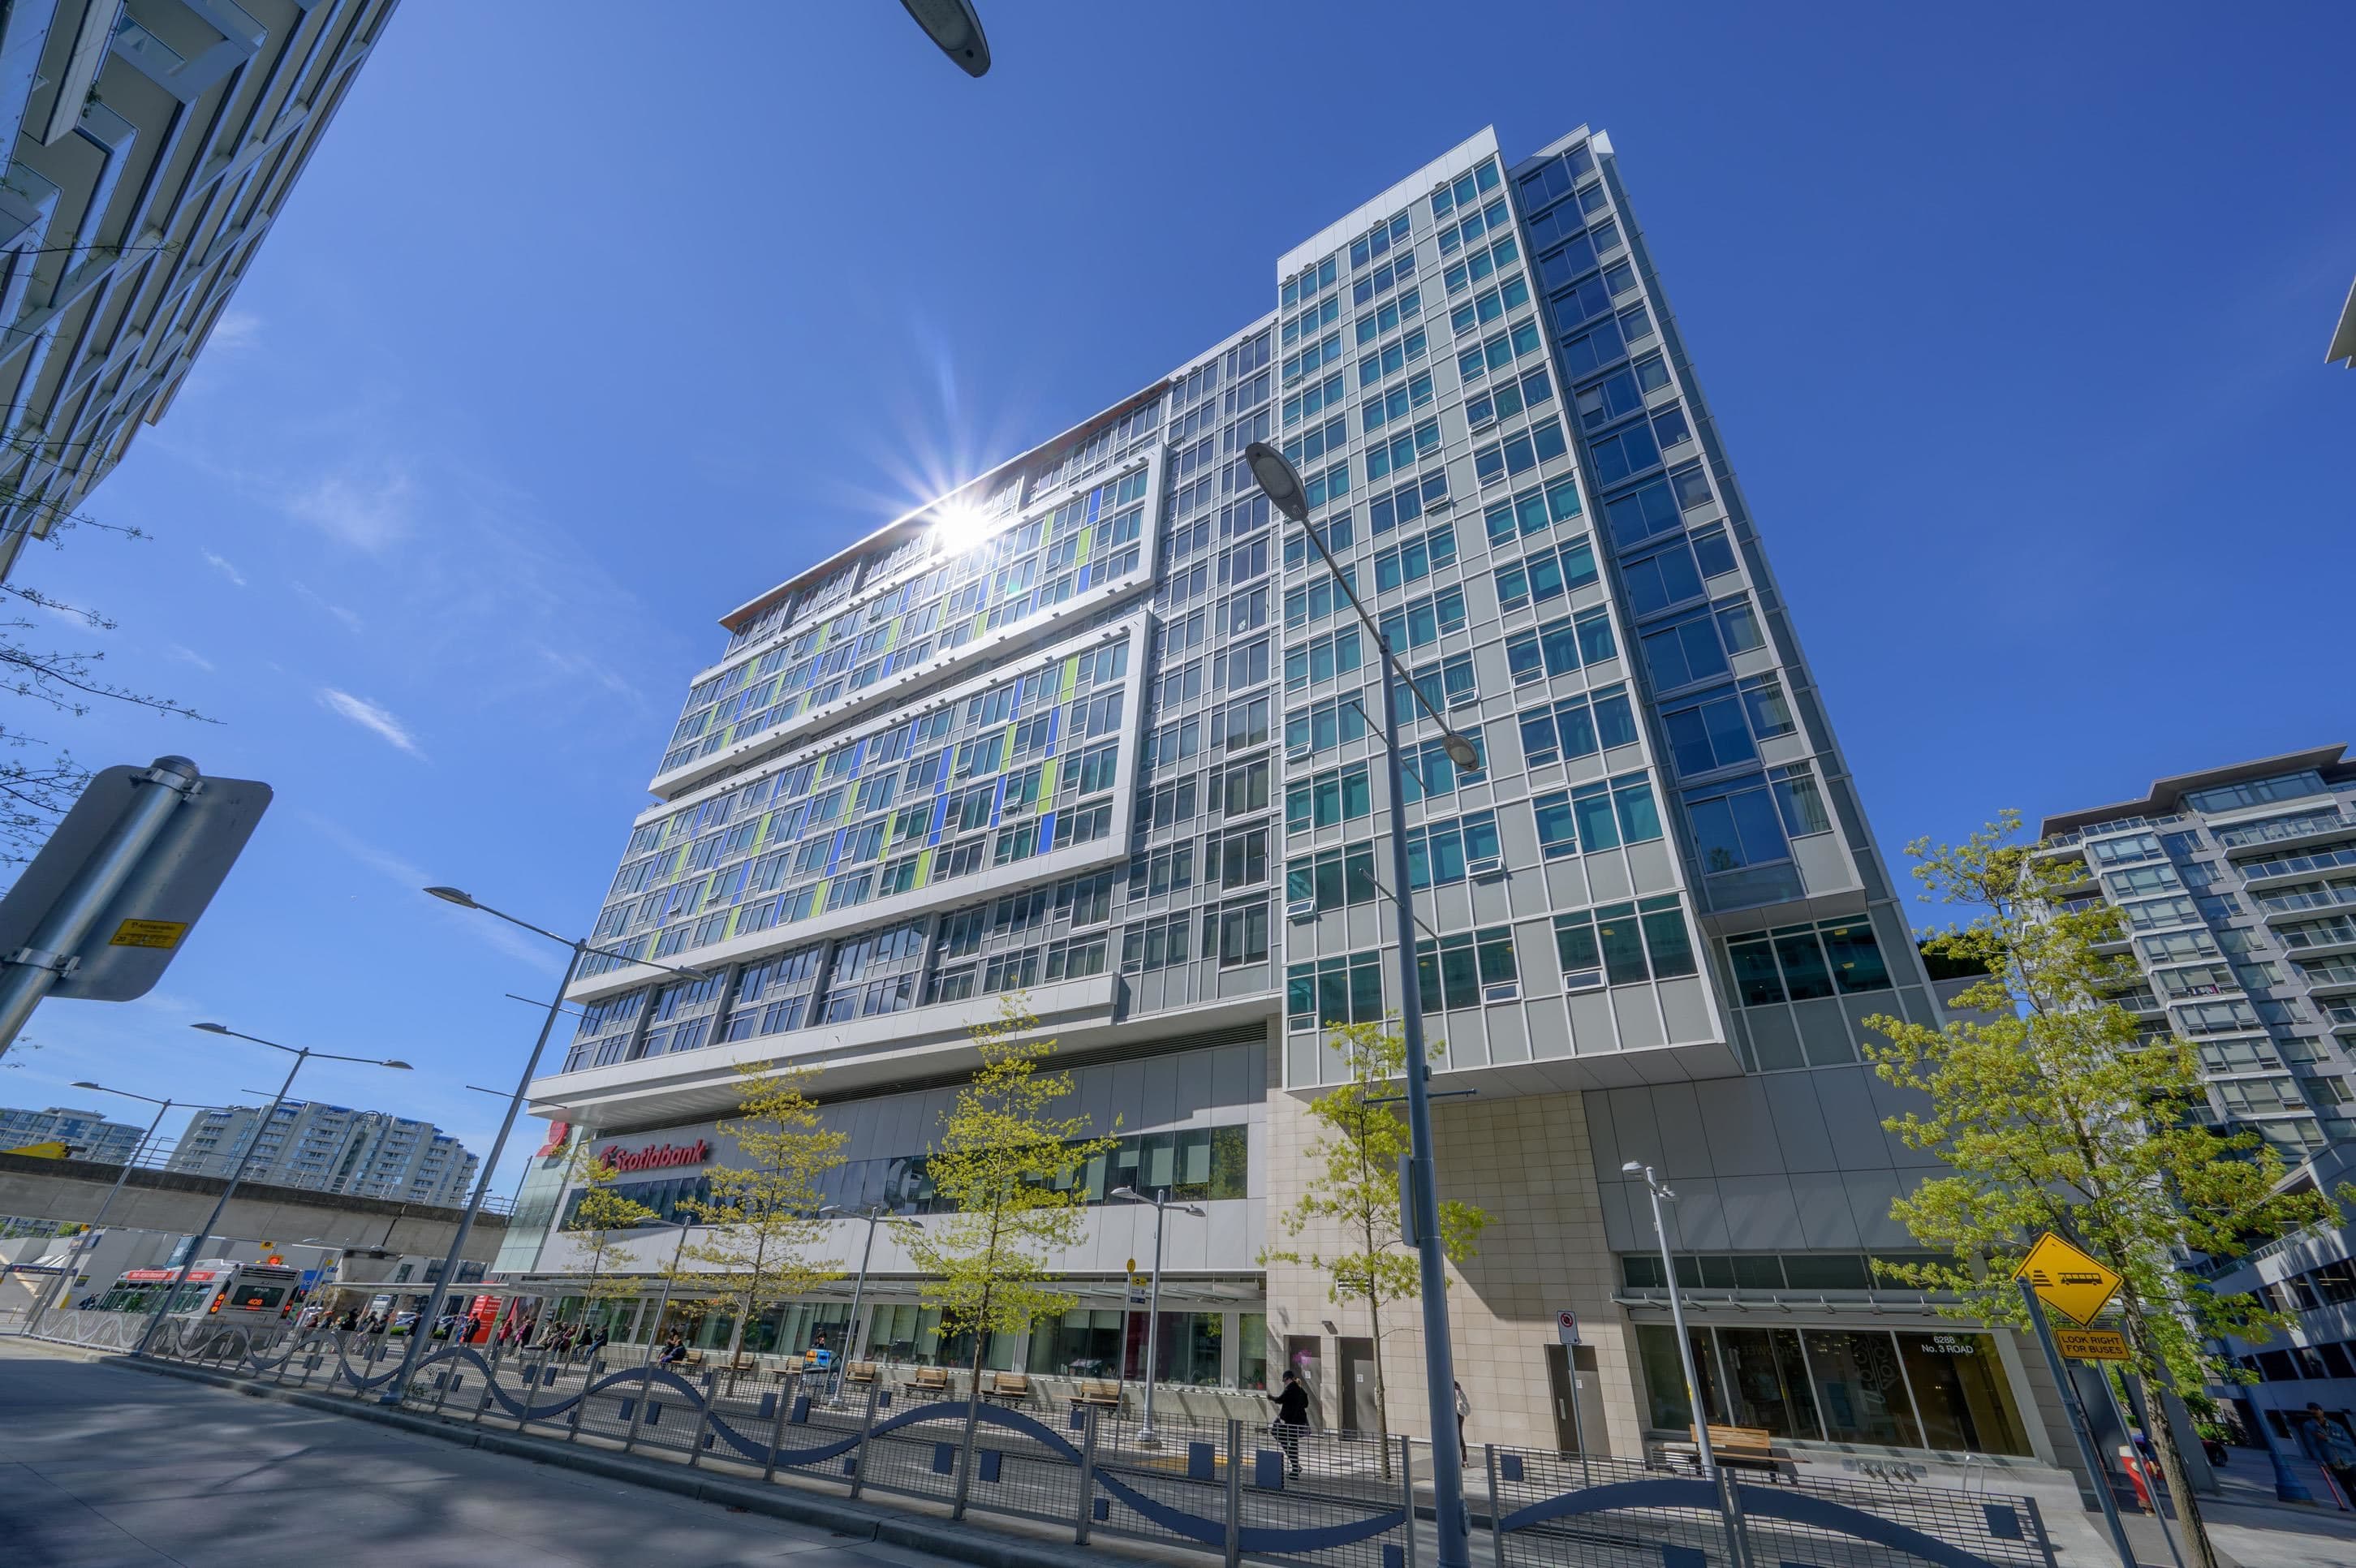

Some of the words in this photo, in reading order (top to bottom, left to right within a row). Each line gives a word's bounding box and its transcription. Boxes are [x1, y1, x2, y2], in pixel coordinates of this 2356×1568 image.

[615, 1139, 709, 1172] Scotiabank
[1933, 1336, 1955, 1344] 6288
[2061, 1337, 2087, 1345] LOOK
[2089, 1337, 2121, 1345] RIGHT
[1921, 1344, 1937, 1353] No.
[1938, 1345, 1945, 1353] 3
[1947, 1345, 1975, 1354] ROAD
[2065, 1345, 2087, 1353] FOR
[2089, 1346, 2123, 1355] BUSES
